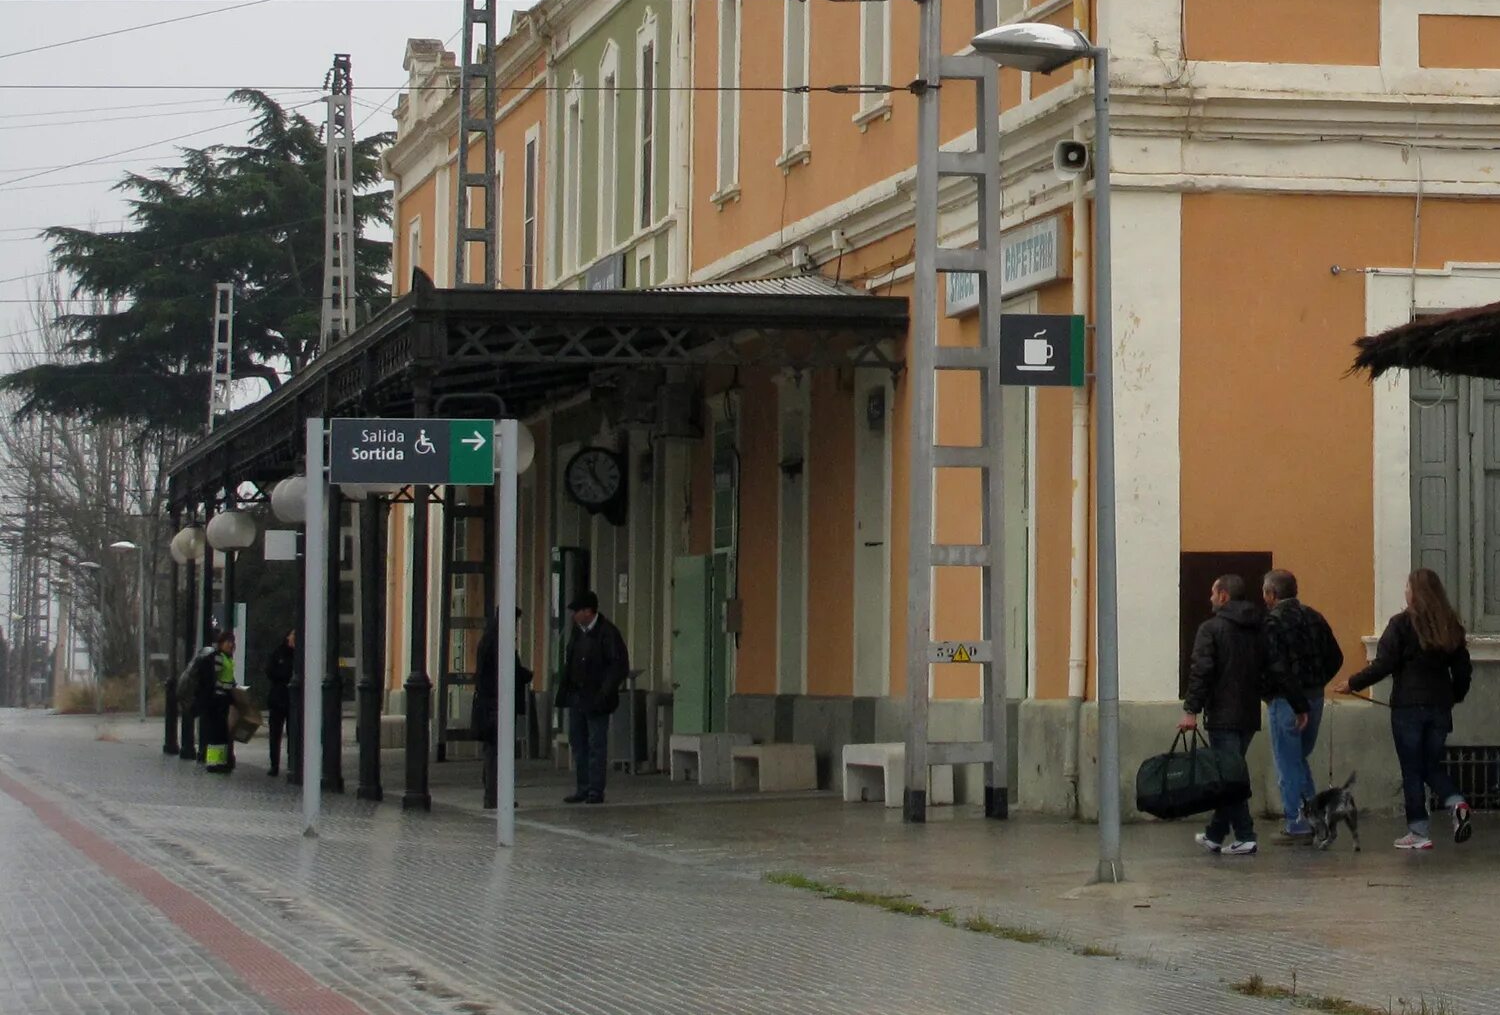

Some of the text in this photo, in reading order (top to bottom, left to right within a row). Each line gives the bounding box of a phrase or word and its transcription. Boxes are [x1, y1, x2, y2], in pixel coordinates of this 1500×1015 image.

[1005, 229, 1054, 282] CAFETERIA
[361, 429, 405, 443] Salida
[351, 447, 404, 461] Sortida
